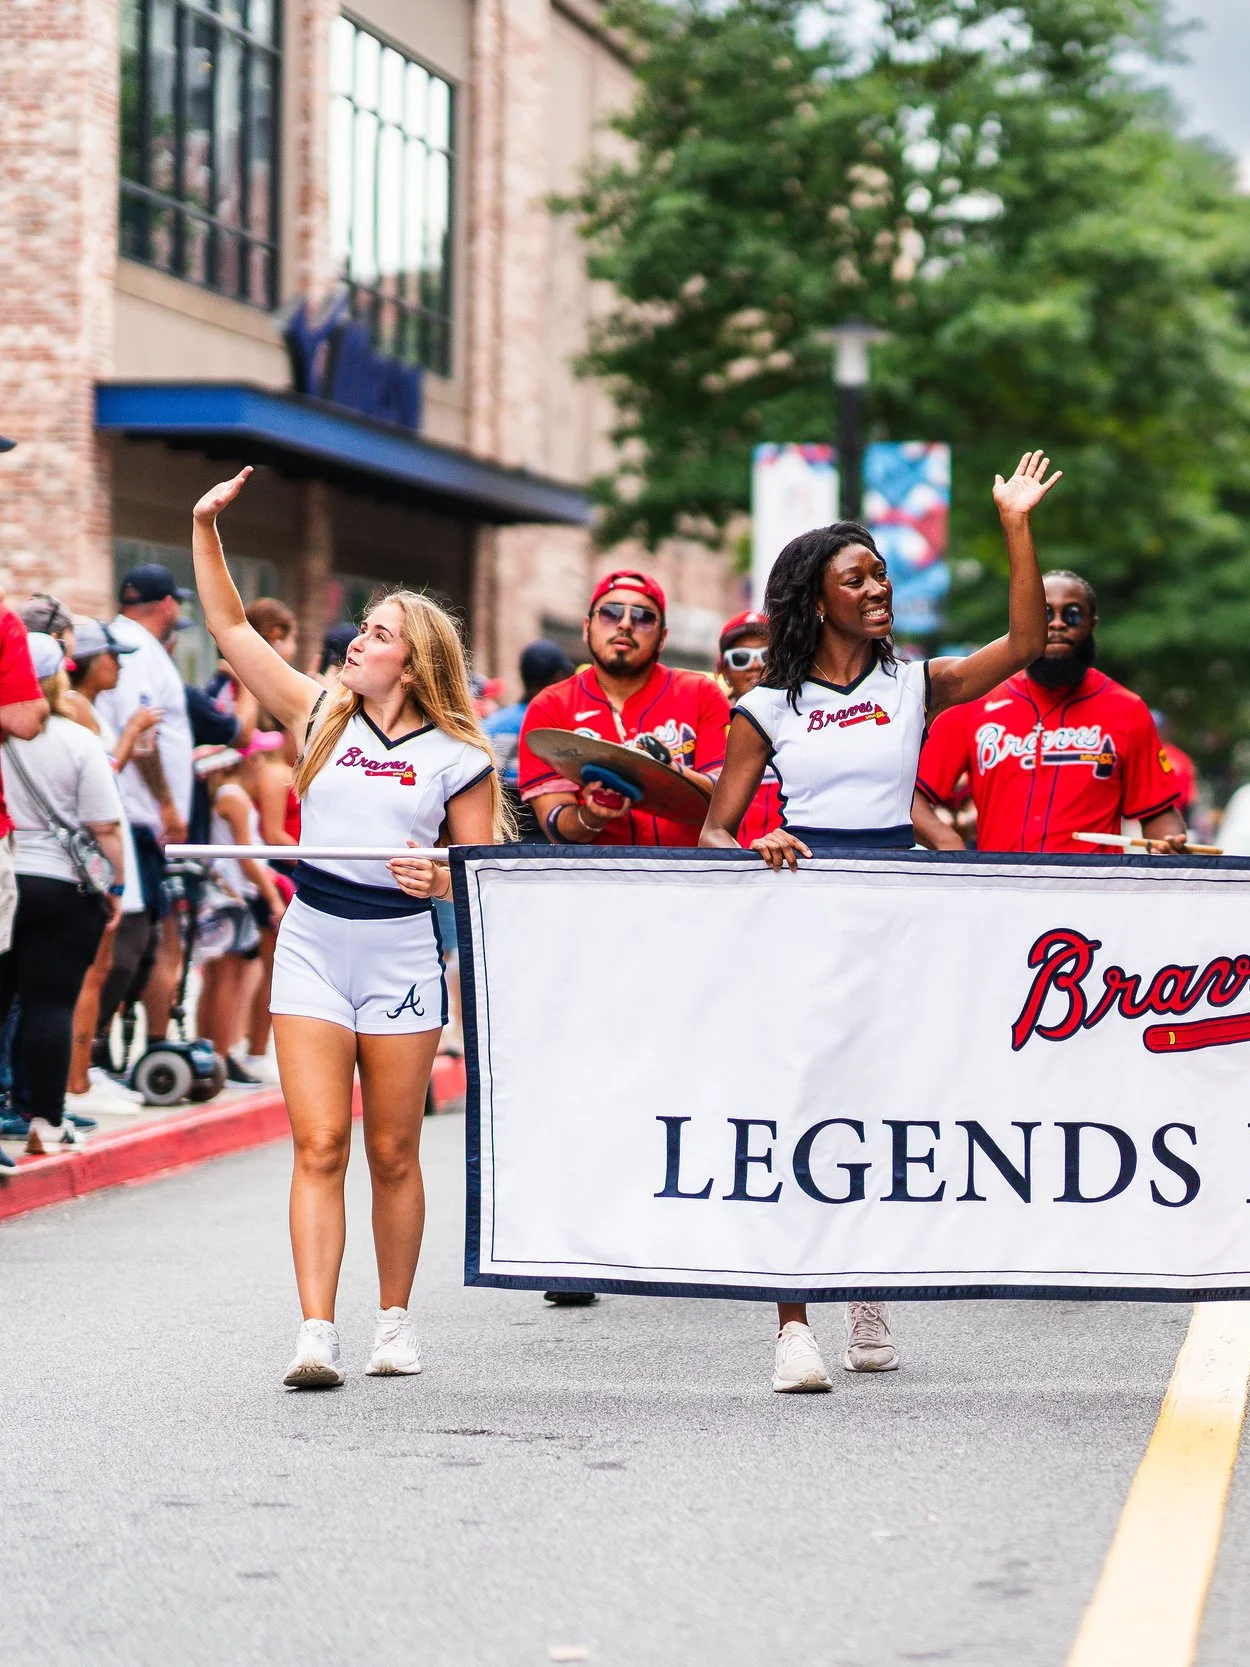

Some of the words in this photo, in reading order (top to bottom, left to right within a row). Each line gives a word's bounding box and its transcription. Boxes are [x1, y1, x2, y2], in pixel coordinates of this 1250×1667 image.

[806, 701, 873, 732] Braves
[336, 747, 407, 770] Braves
[975, 722, 1101, 776] Braves
[386, 983, 425, 1019] A
[653, 1115, 1201, 1208] LEGENDS
